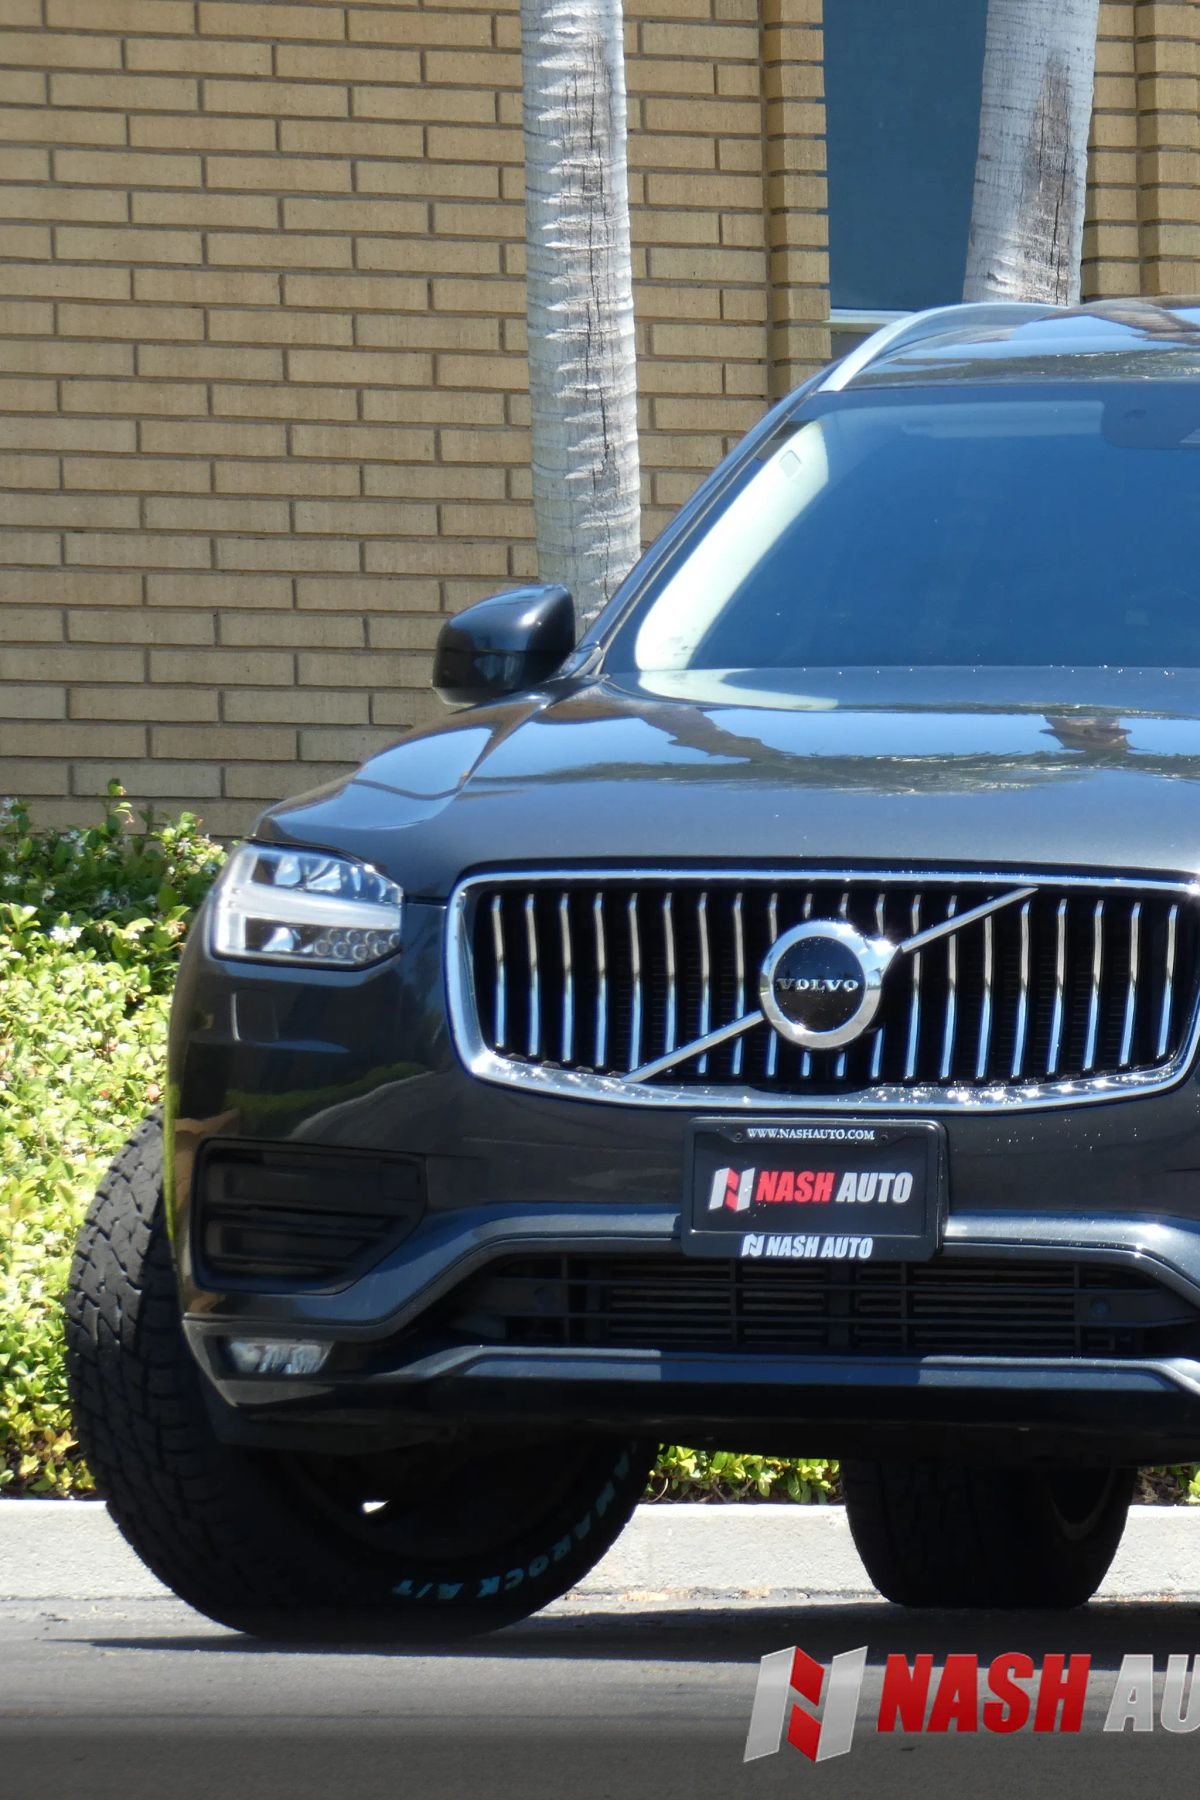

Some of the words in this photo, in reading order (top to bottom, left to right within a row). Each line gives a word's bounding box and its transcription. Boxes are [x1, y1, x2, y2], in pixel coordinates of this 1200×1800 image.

[776, 978, 859, 992] VOLVO
[746, 1127, 876, 1141] WWW.NASHAUTO.COM
[755, 1170, 836, 1204] NASH
[835, 1171, 914, 1204] AUTO
[765, 1235, 819, 1258] NASH
[820, 1235, 874, 1259] AUTO
